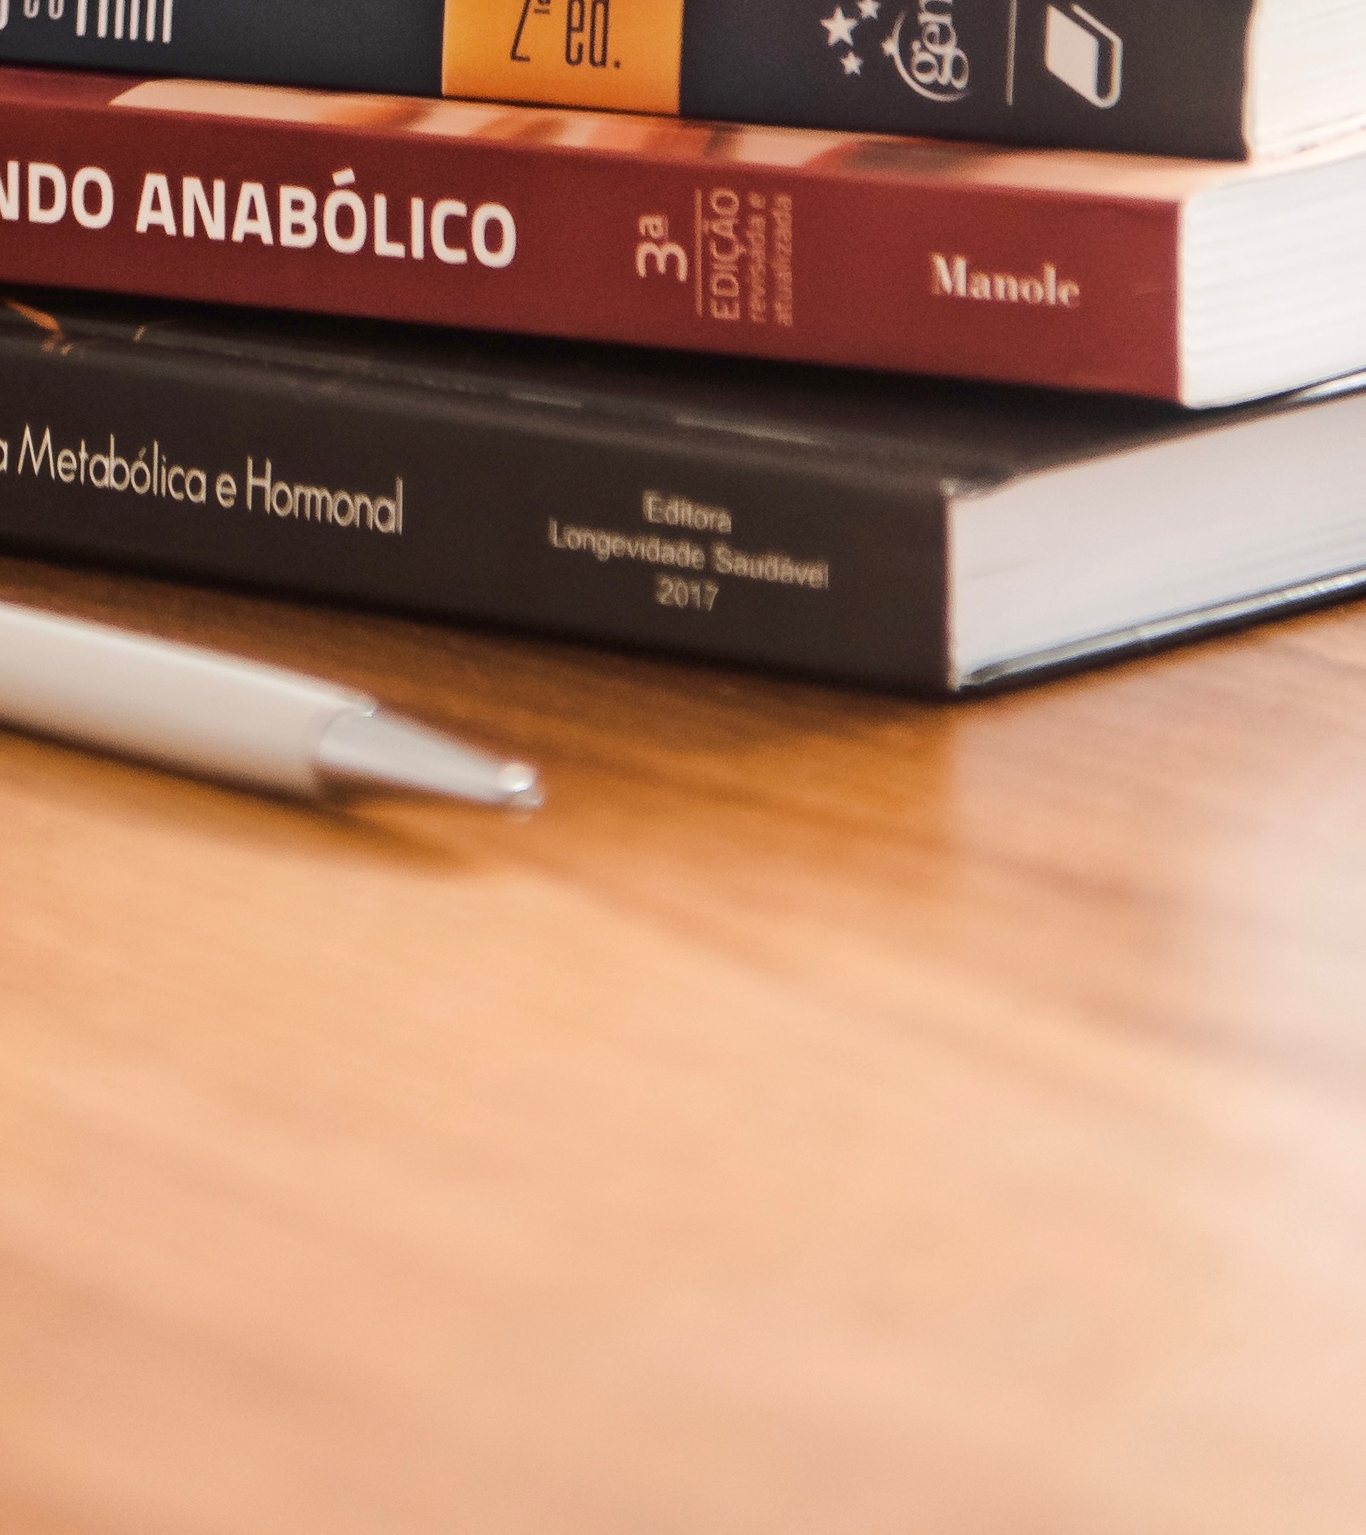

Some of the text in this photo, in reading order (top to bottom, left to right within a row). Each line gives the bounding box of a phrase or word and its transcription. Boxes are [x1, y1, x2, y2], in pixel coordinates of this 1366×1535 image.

[135, 167, 516, 269] ANABÓLICO
[703, 186, 746, 321] EDIÇÃO
[930, 252, 1080, 308] Manole
[17, 423, 207, 504] Metabólica
[215, 469, 236, 508] e
[247, 454, 404, 535] Hormonal
[642, 488, 732, 534] Editora
[548, 517, 829, 589] Longevidade Saudável
[655, 573, 719, 612] 2017
